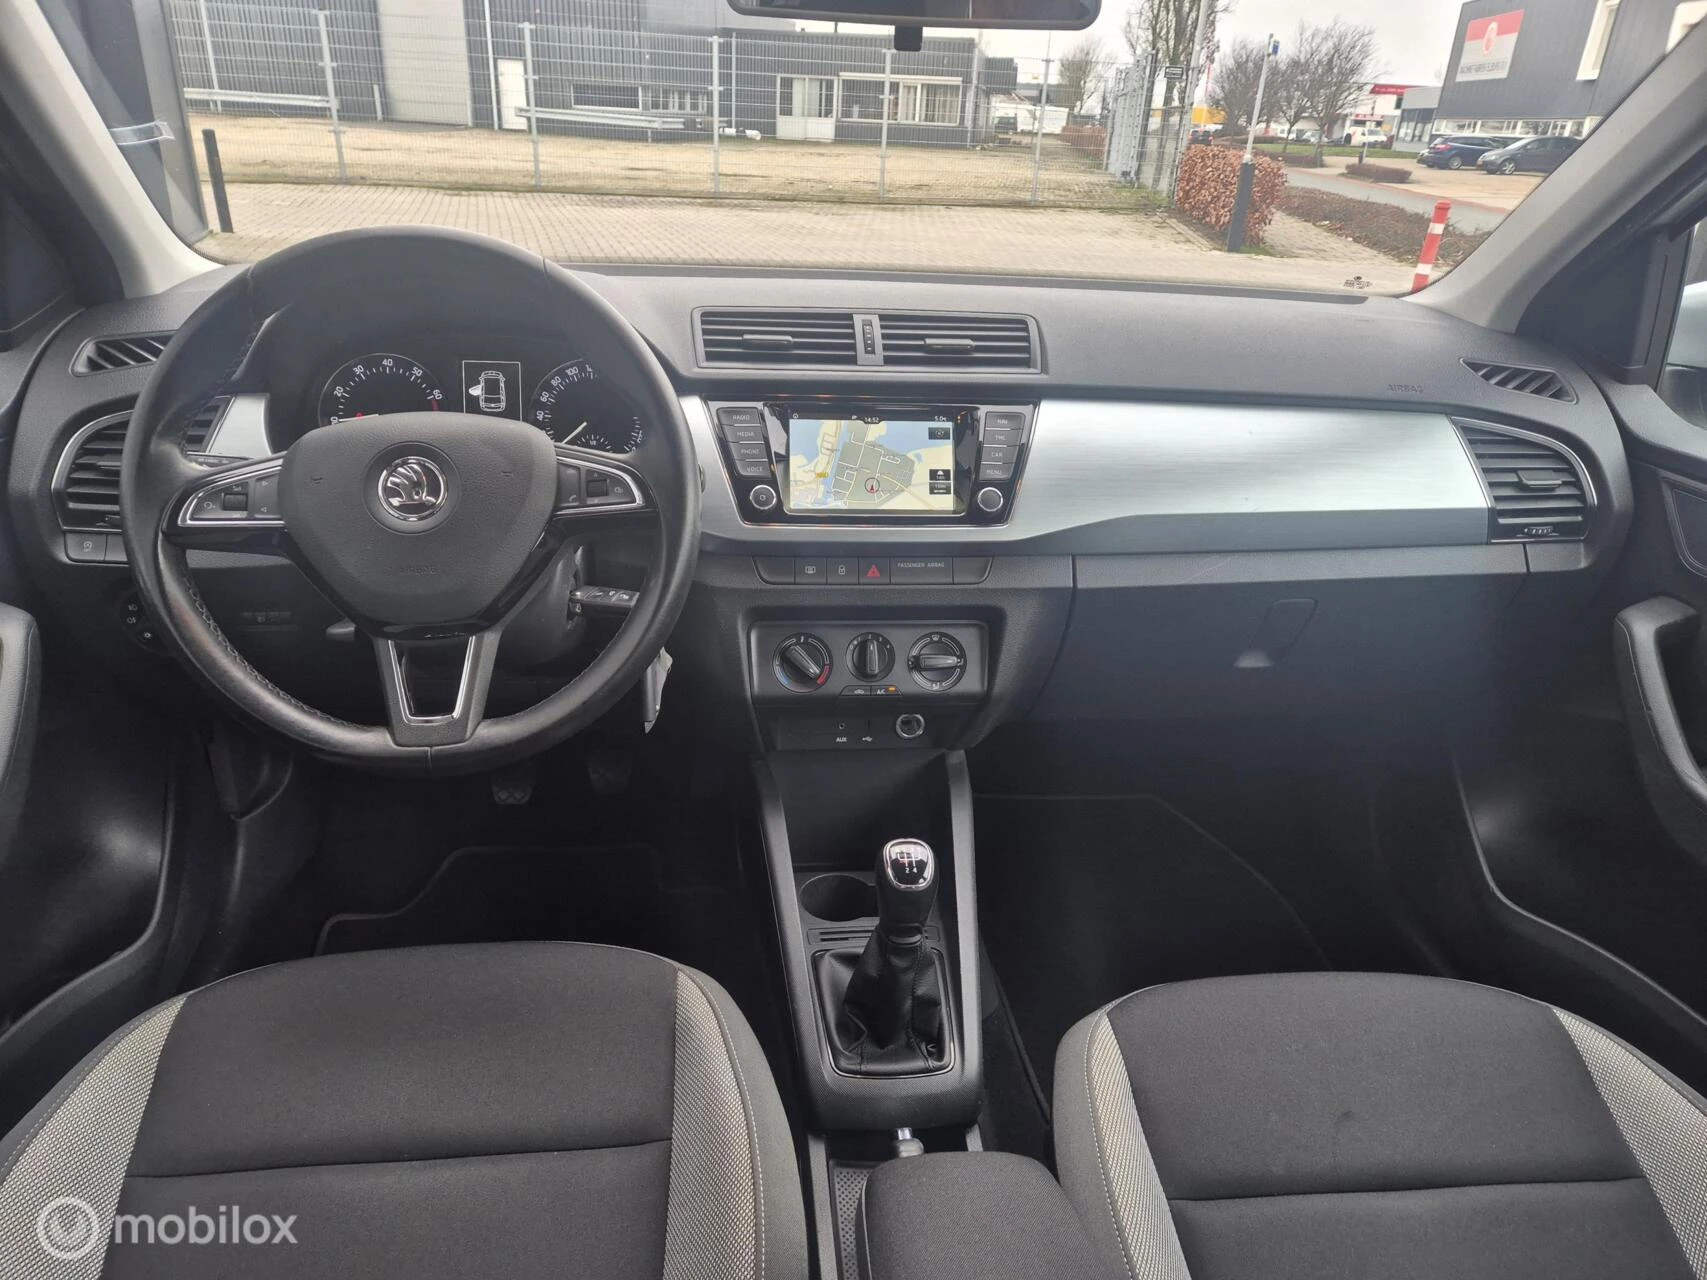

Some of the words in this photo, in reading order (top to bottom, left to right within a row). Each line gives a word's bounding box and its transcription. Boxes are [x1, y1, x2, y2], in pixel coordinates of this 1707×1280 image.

[382, 358, 394, 367] 40
[352, 364, 365, 376] 30
[411, 366, 423, 378] 50
[565, 366, 579, 377] 100
[550, 375, 562, 388] 80
[333, 385, 344, 397] 20
[432, 388, 443, 401] 60
[540, 391, 550, 403] 60
[536, 410, 545, 421] 40
[736, 430, 755, 438] MEDIA
